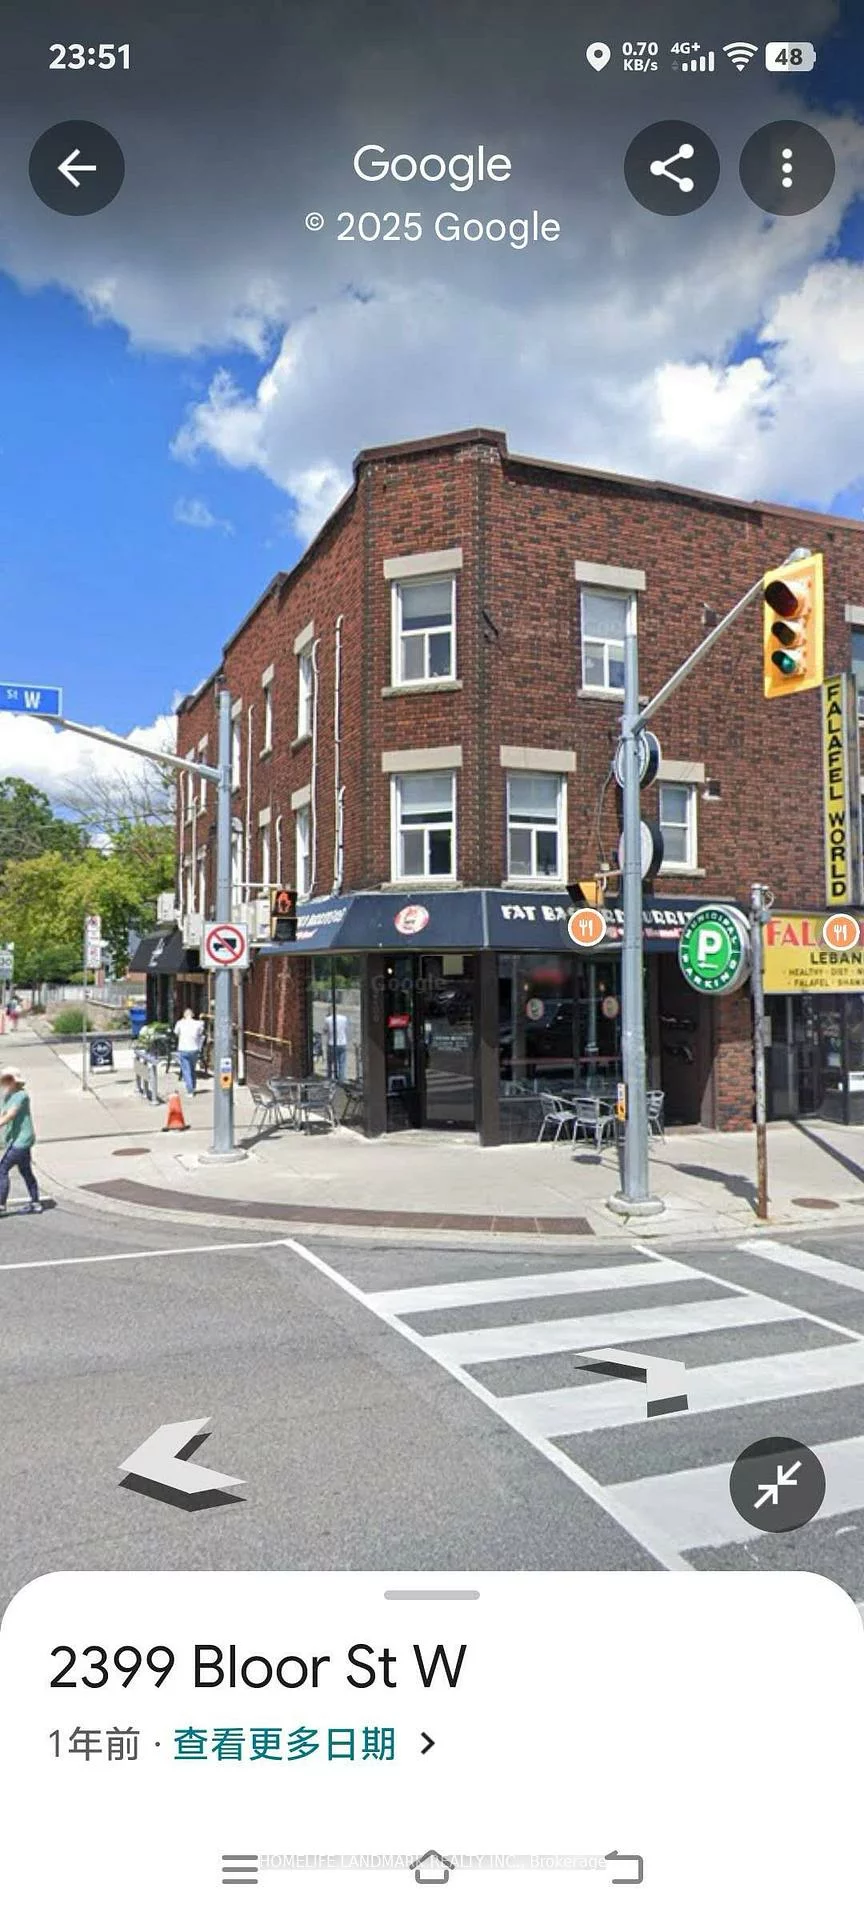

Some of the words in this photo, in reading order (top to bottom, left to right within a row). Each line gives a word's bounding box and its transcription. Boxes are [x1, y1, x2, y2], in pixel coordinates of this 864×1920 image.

[24, 690, 41, 709] W
[827, 684, 843, 801] FALAFEL
[829, 812, 847, 897] WORLD
[500, 904, 537, 921] FAT
[696, 928, 723, 962] P
[681, 953, 737, 989] PARKING
